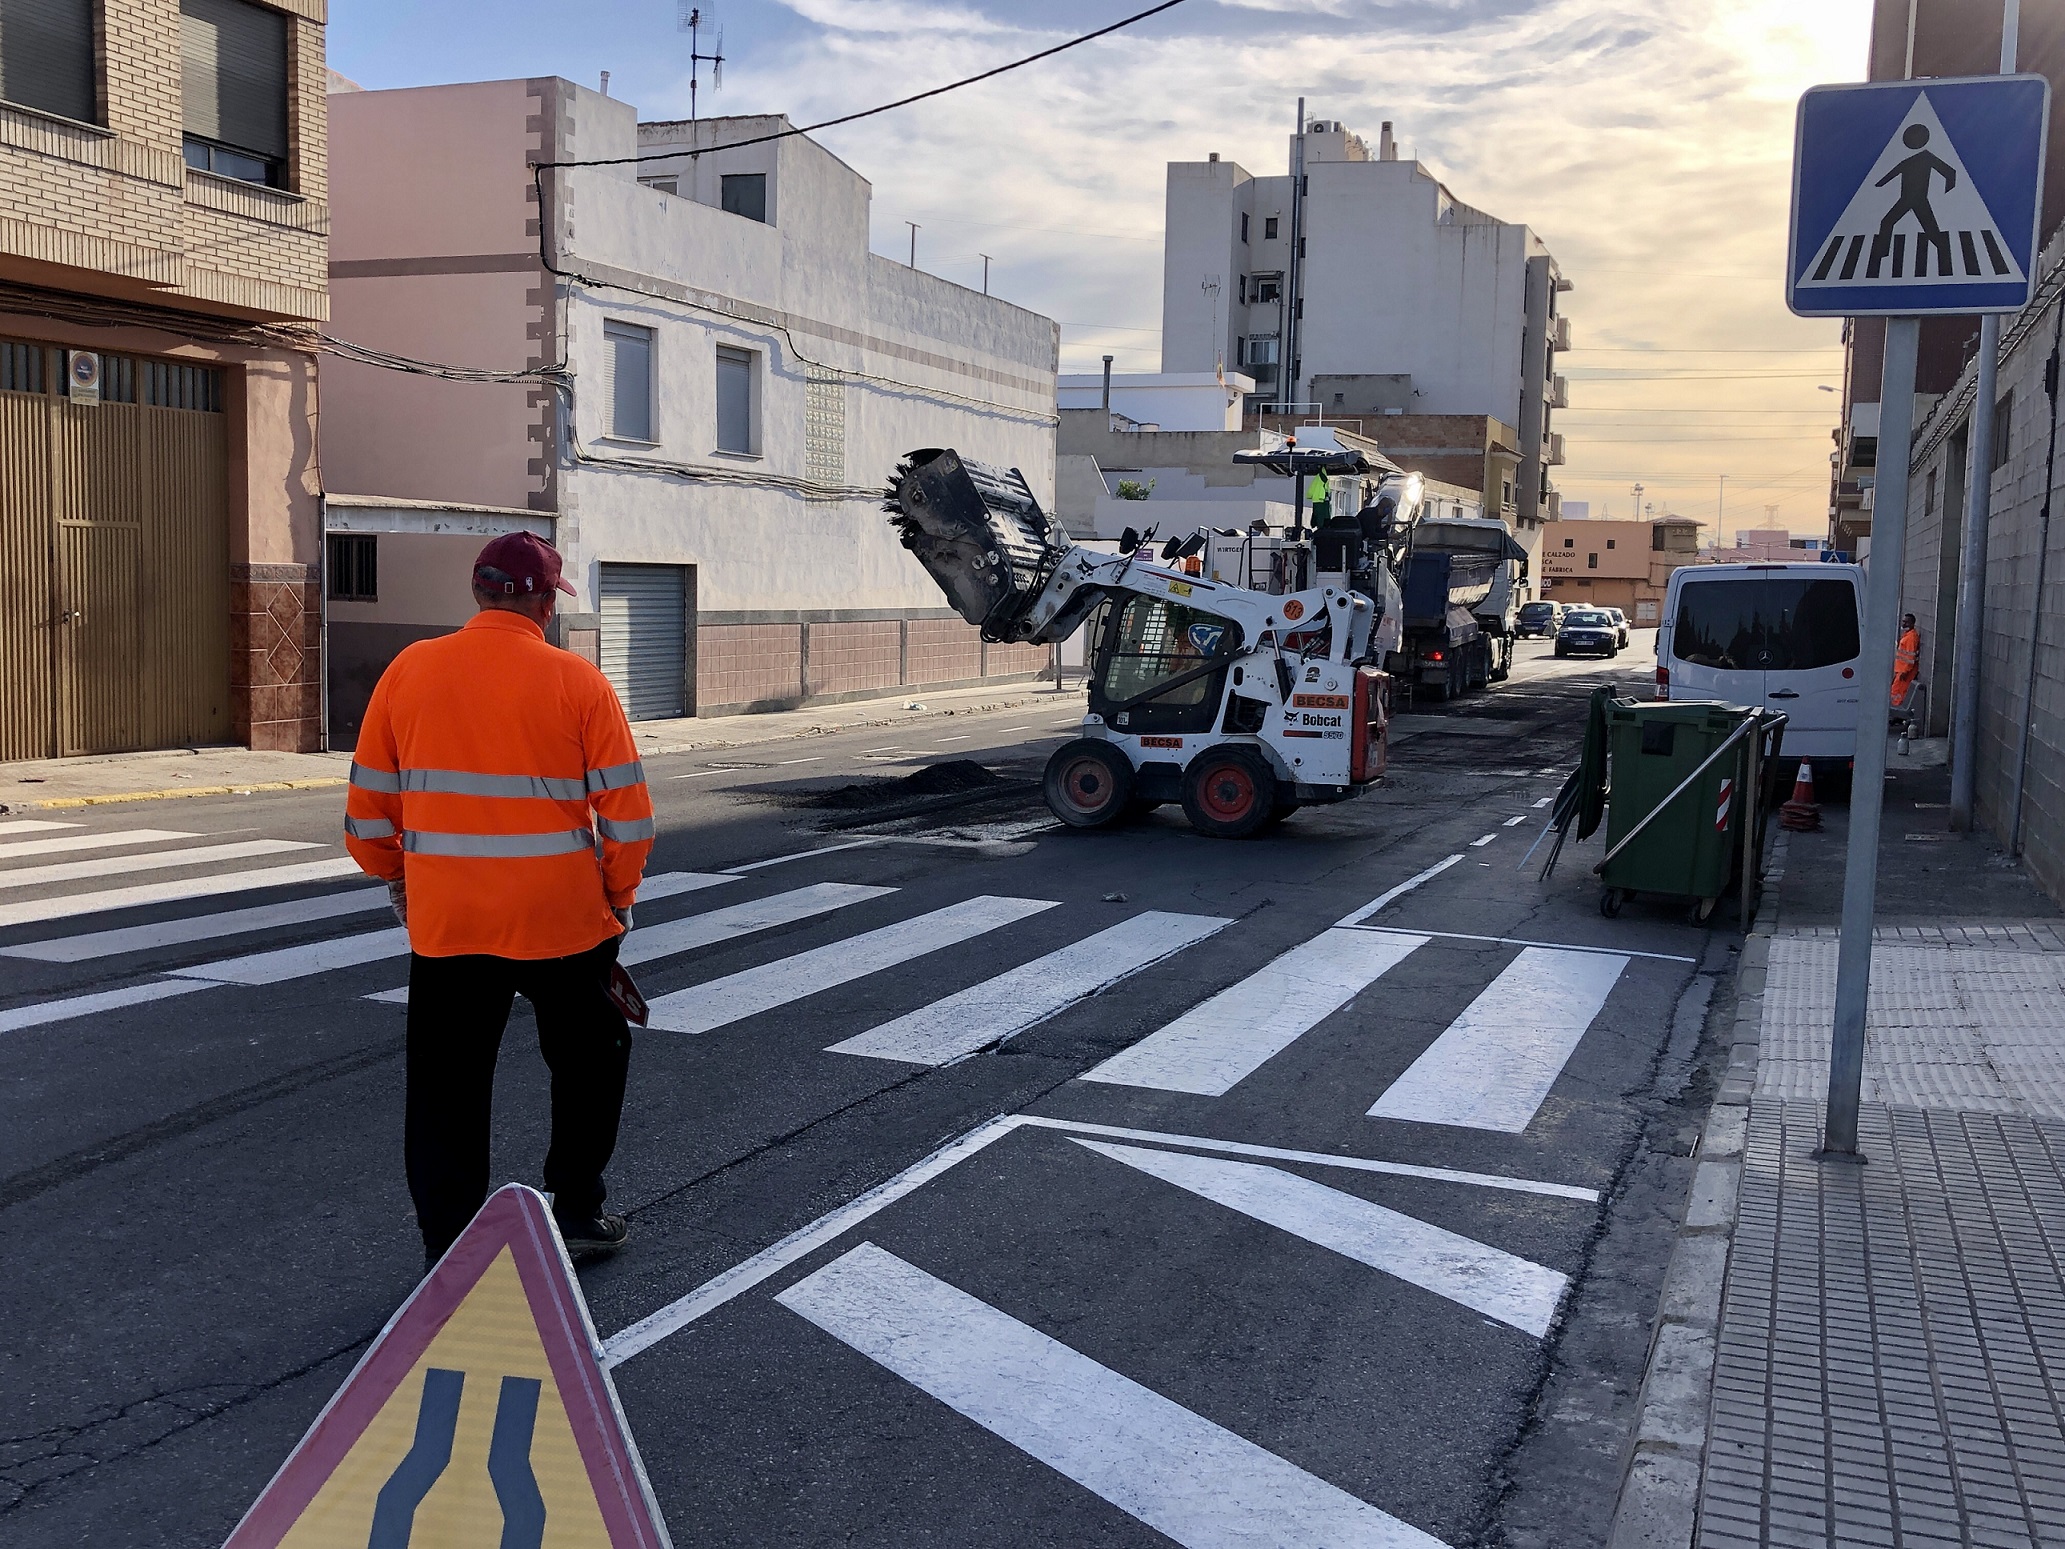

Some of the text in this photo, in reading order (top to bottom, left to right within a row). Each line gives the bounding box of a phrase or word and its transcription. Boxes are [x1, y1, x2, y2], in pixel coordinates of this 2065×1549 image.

[1285, 601, 1303, 619] 613
[1304, 666, 1321, 683] 2
[1296, 696, 1346, 707] BECSA
[1302, 713, 1342, 727] Bobcat
[1143, 737, 1181, 747] BECSA
[610, 981, 642, 1016] ST
